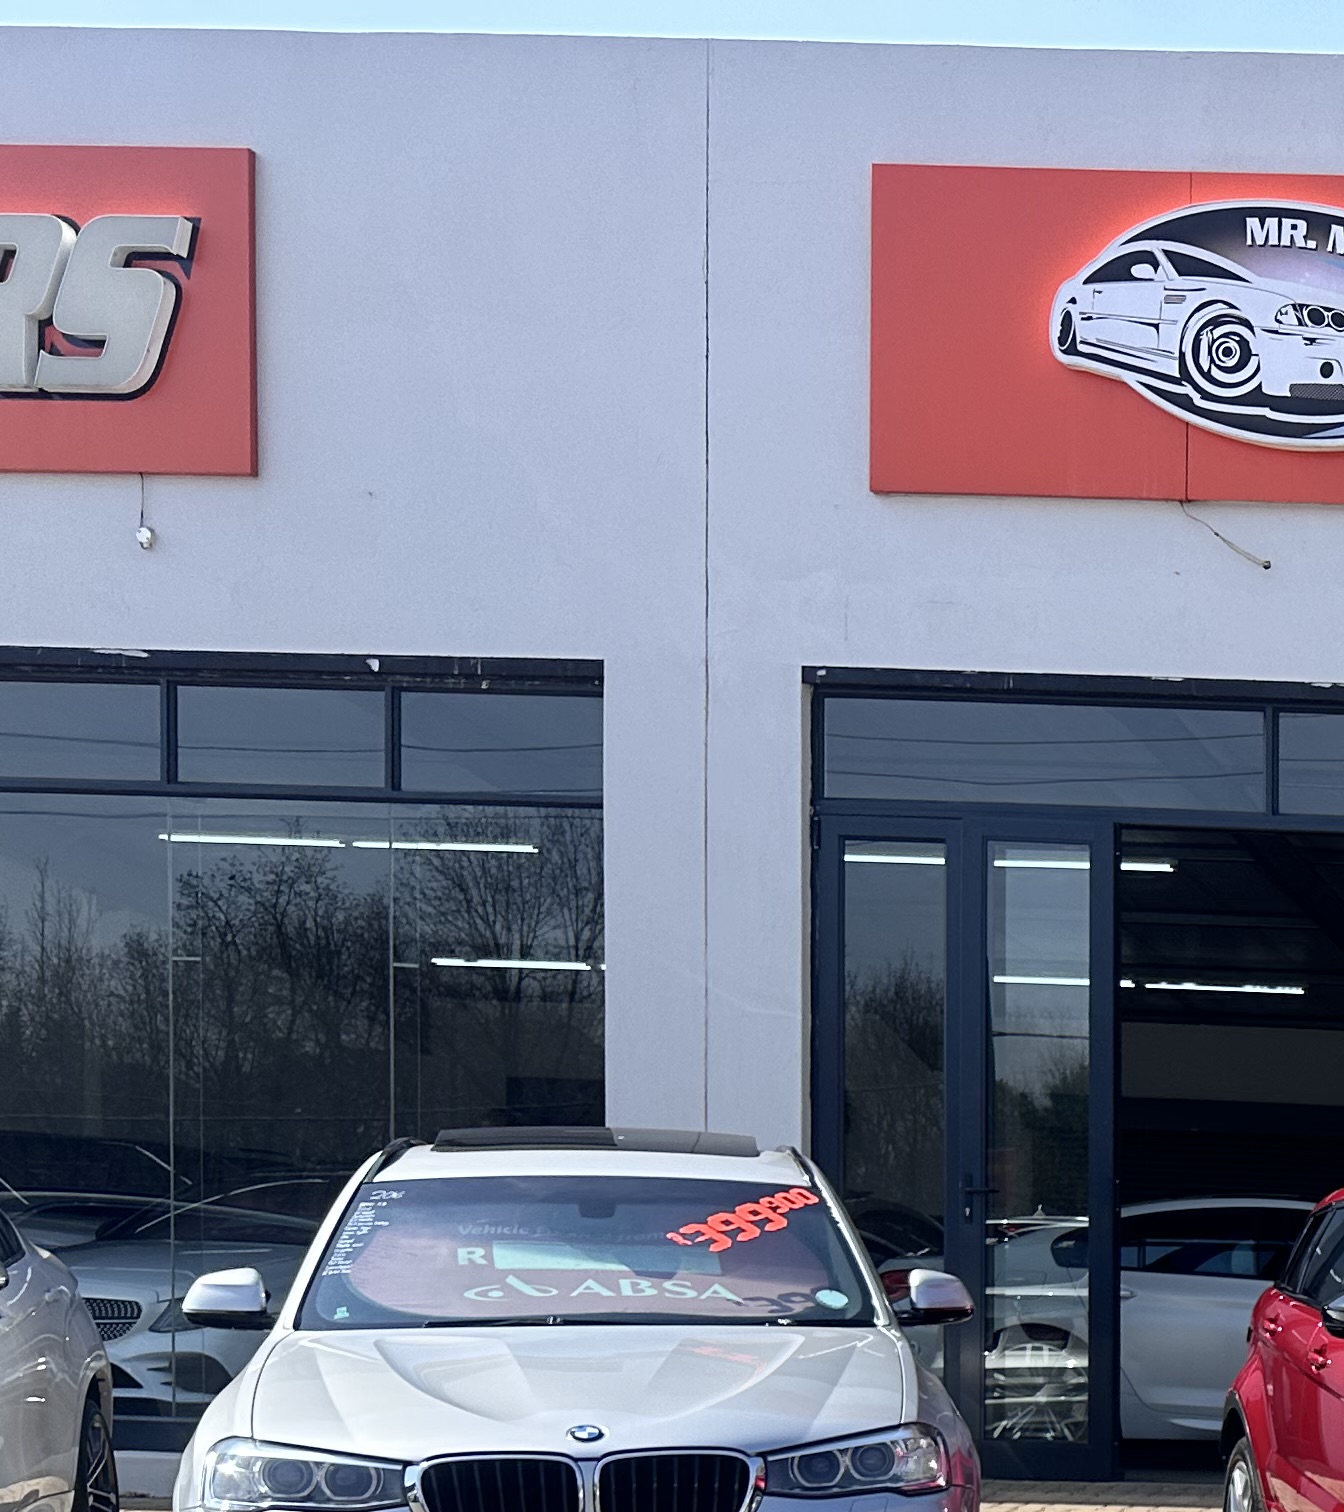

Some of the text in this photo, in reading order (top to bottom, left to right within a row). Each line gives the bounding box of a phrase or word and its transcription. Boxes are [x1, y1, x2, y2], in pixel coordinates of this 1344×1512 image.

[1246, 216, 1318, 250] MR.
[457, 1247, 488, 1265] R
[569, 1279, 744, 1305] ABSA
